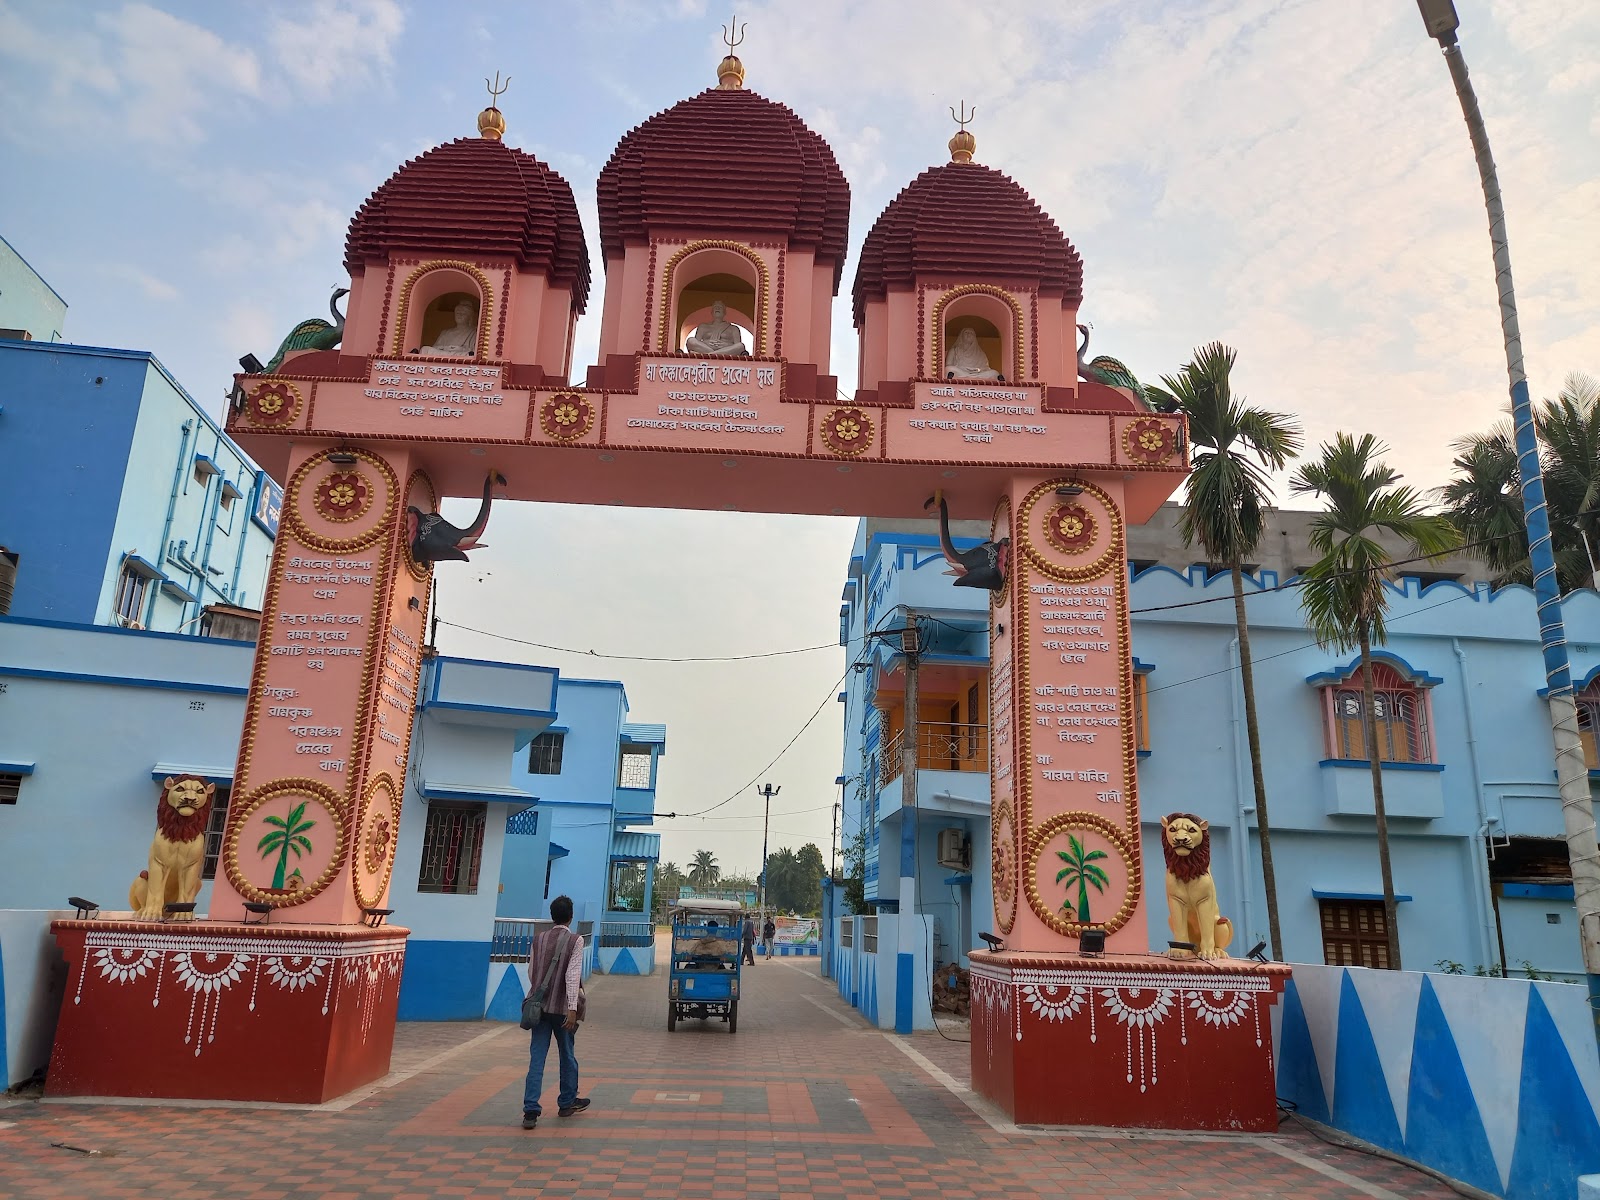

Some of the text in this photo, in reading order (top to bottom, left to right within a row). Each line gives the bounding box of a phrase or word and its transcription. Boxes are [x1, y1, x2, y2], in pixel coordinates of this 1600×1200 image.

[374, 361, 500, 377] জীবে প্রেম করে যেই জন
[645, 363, 658, 382] মা
[720, 365, 752, 385] প্রবেশ
[756, 367, 776, 389] দ্বার
[378, 375, 495, 391] সেই জন সেবিছে ঈশ্বর
[364, 389, 384, 399] যার
[385, 388, 419, 401] নিজের
[420, 392, 449, 403] ওপর
[482, 394, 503, 405] নাই
[667, 390, 751, 405] যত মত তত পথ
[930, 386, 1028, 401] আমি সত্যিকারের মা
[400, 405, 425, 416] সেই
[657, 404, 759, 420] টাকা মাটি মাটি টাকা
[921, 401, 941, 411] গুরু
[965, 404, 983, 414] নয়
[1023, 407, 1036, 416] মা
[626, 418, 785, 435] তোমাদের সকলের চৈতন্য হোক
[909, 419, 1047, 435] নয় কথার কথার মা নয় সত্য
[963, 433, 994, 443] জননী
[289, 557, 334, 571] জীবনের
[341, 573, 373, 586] উপায়
[313, 589, 338, 599] প্রেম
[1030, 583, 1057, 595] আমি
[1100, 586, 1114, 596] মা
[310, 613, 337, 624] দর্শন
[287, 630, 350, 644] রমন সুখের
[1043, 625, 1076, 635] আমার
[270, 643, 305, 656] কোটি
[326, 647, 362, 657] আনন্দ
[1075, 641, 1111, 652] আমার
[1060, 653, 1087, 664] ছেলে
[307, 660, 326, 672] হয়
[1035, 684, 1117, 697] যদি শান্তি চাও মা
[268, 706, 313, 722] রামকৃষ্ণ
[1066, 702, 1092, 712] দোষ
[1095, 702, 1117, 712] দেখ
[1057, 717, 1082, 726] দোষ
[1084, 717, 1120, 727] দেখবে
[288, 725, 343, 738] পরমহংস
[1057, 730, 1098, 744] নিজের
[296, 743, 333, 755] দেবের
[319, 758, 346, 772] বাণী
[1042, 770, 1076, 782] সারদা
[1096, 789, 1122, 803] বাণী
